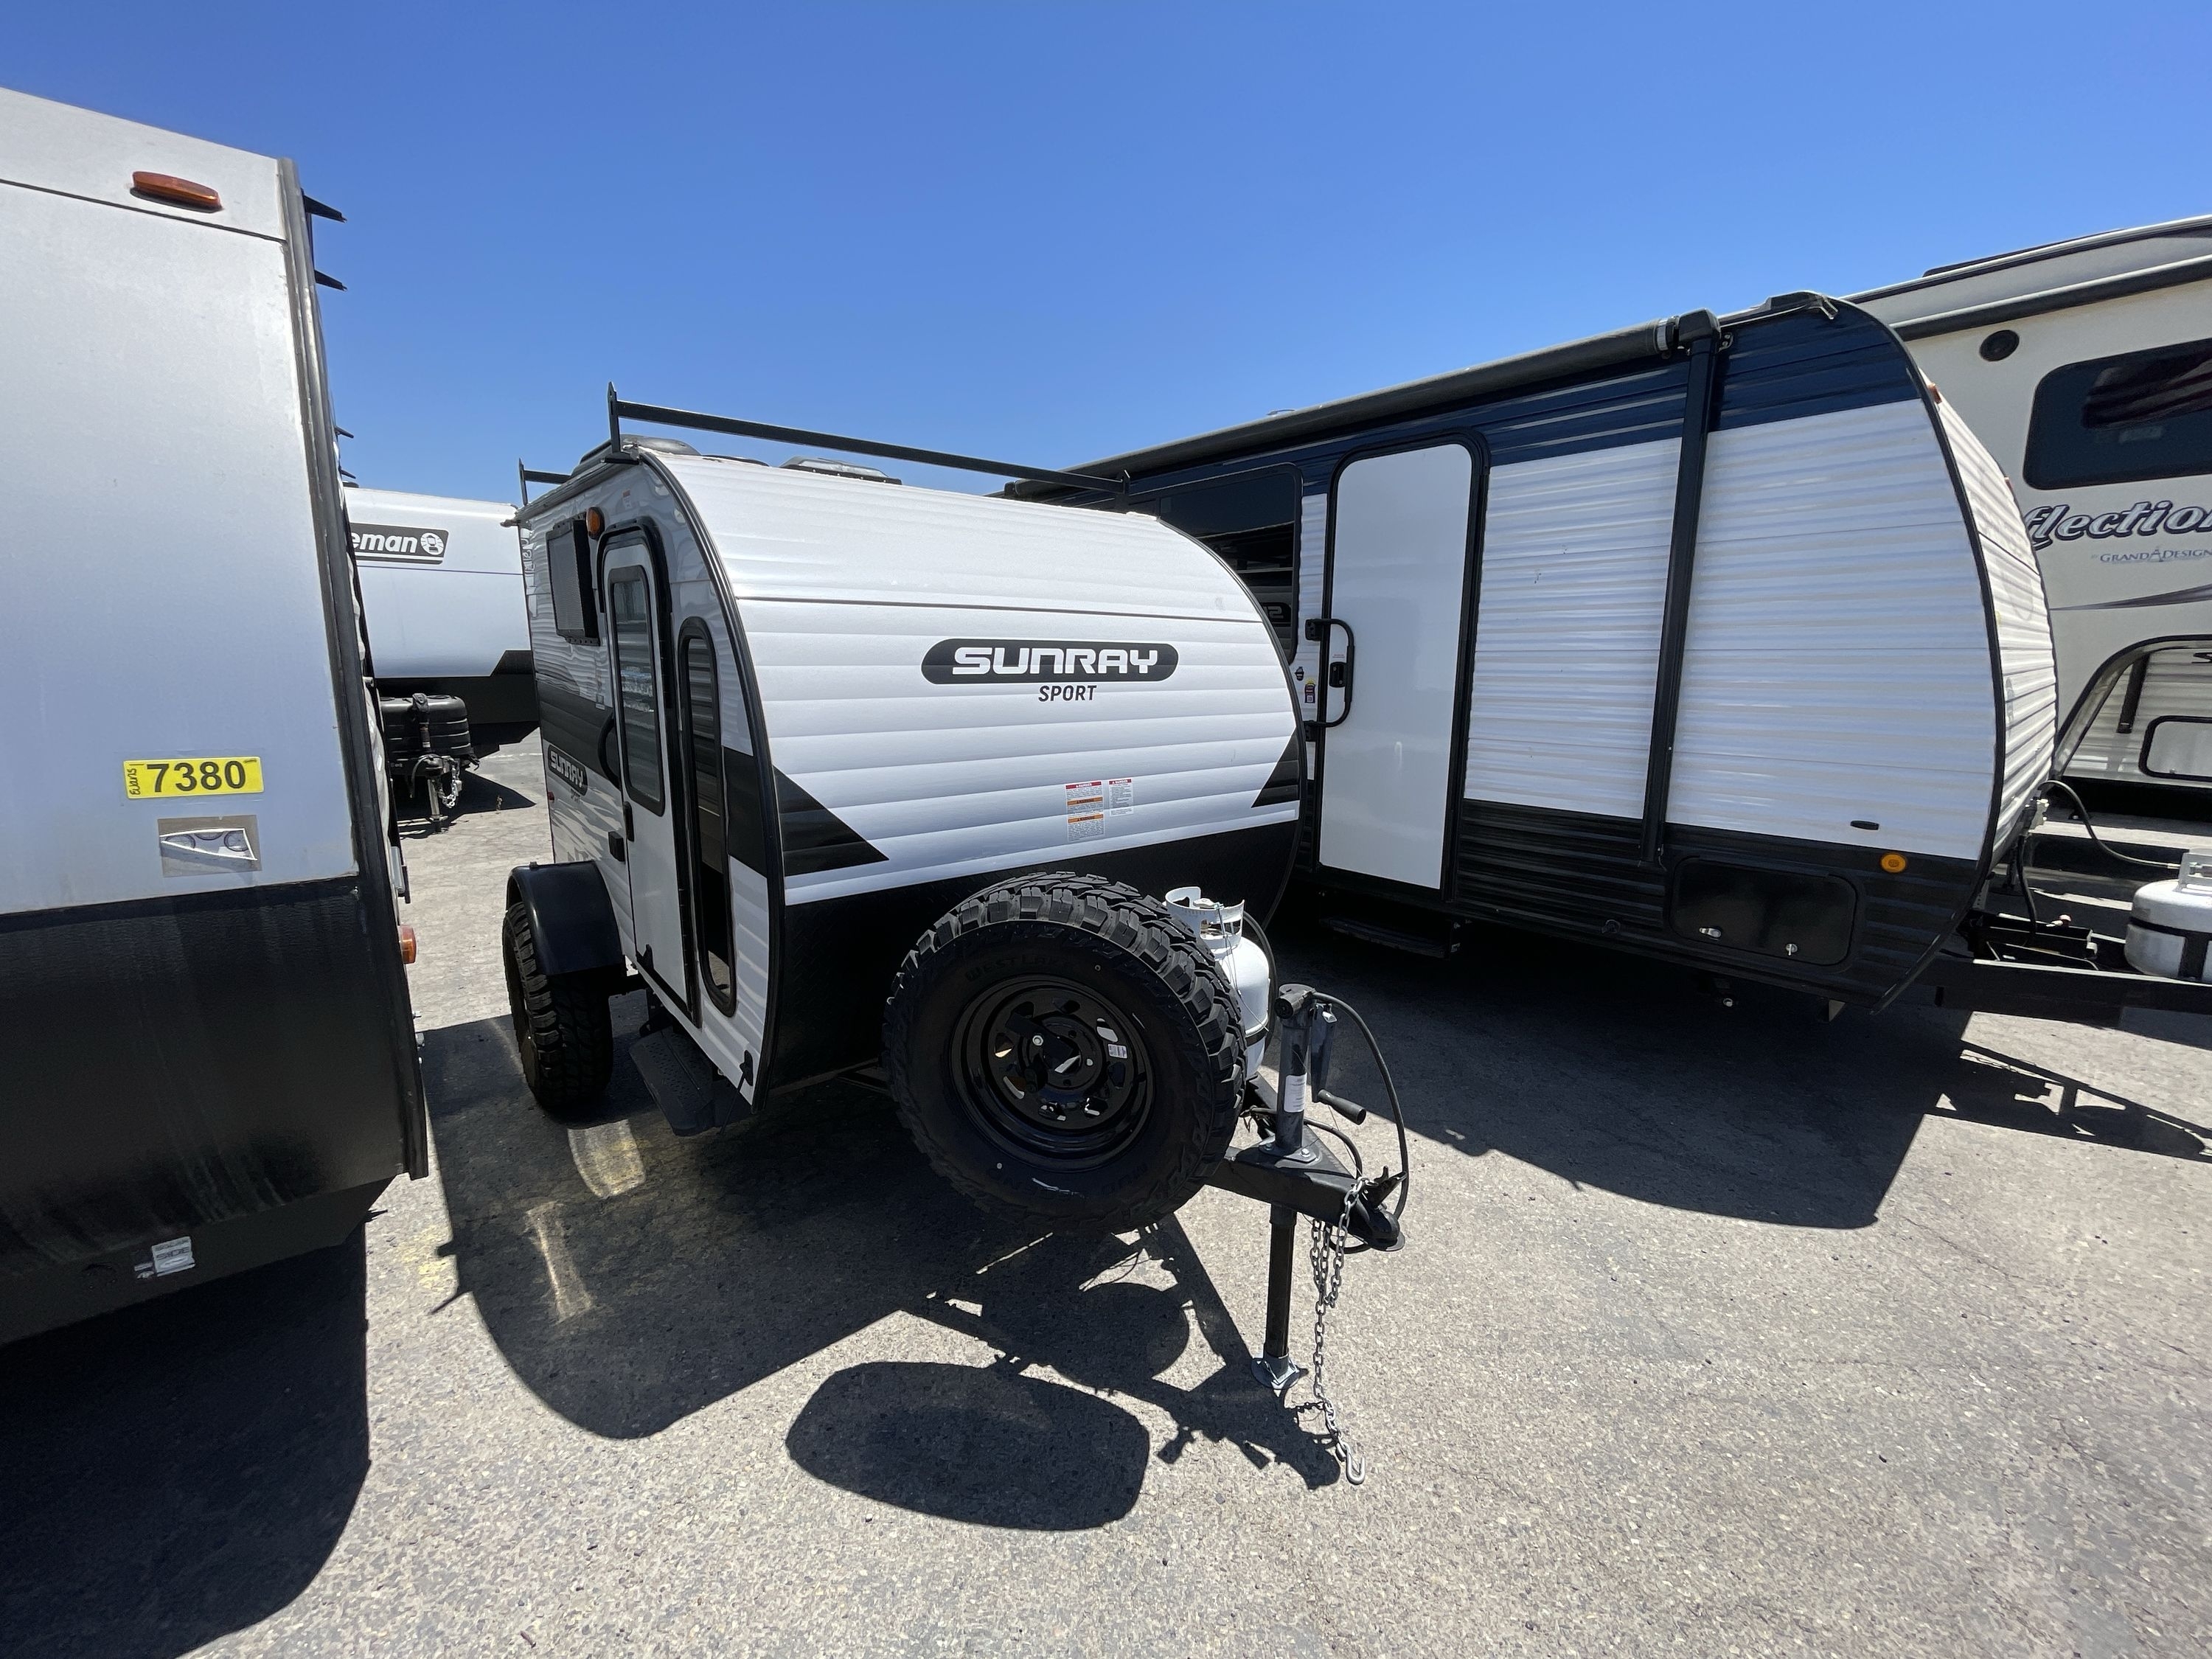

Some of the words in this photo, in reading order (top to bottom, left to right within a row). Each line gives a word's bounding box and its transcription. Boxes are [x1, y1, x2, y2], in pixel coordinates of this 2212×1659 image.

[2099, 552, 2149, 562] GRAND
[952, 647, 1158, 675] SUNRAY
[1037, 684, 1098, 702] SPORT
[146, 760, 246, 793] 7380
[550, 750, 584, 788] SUNRAY
